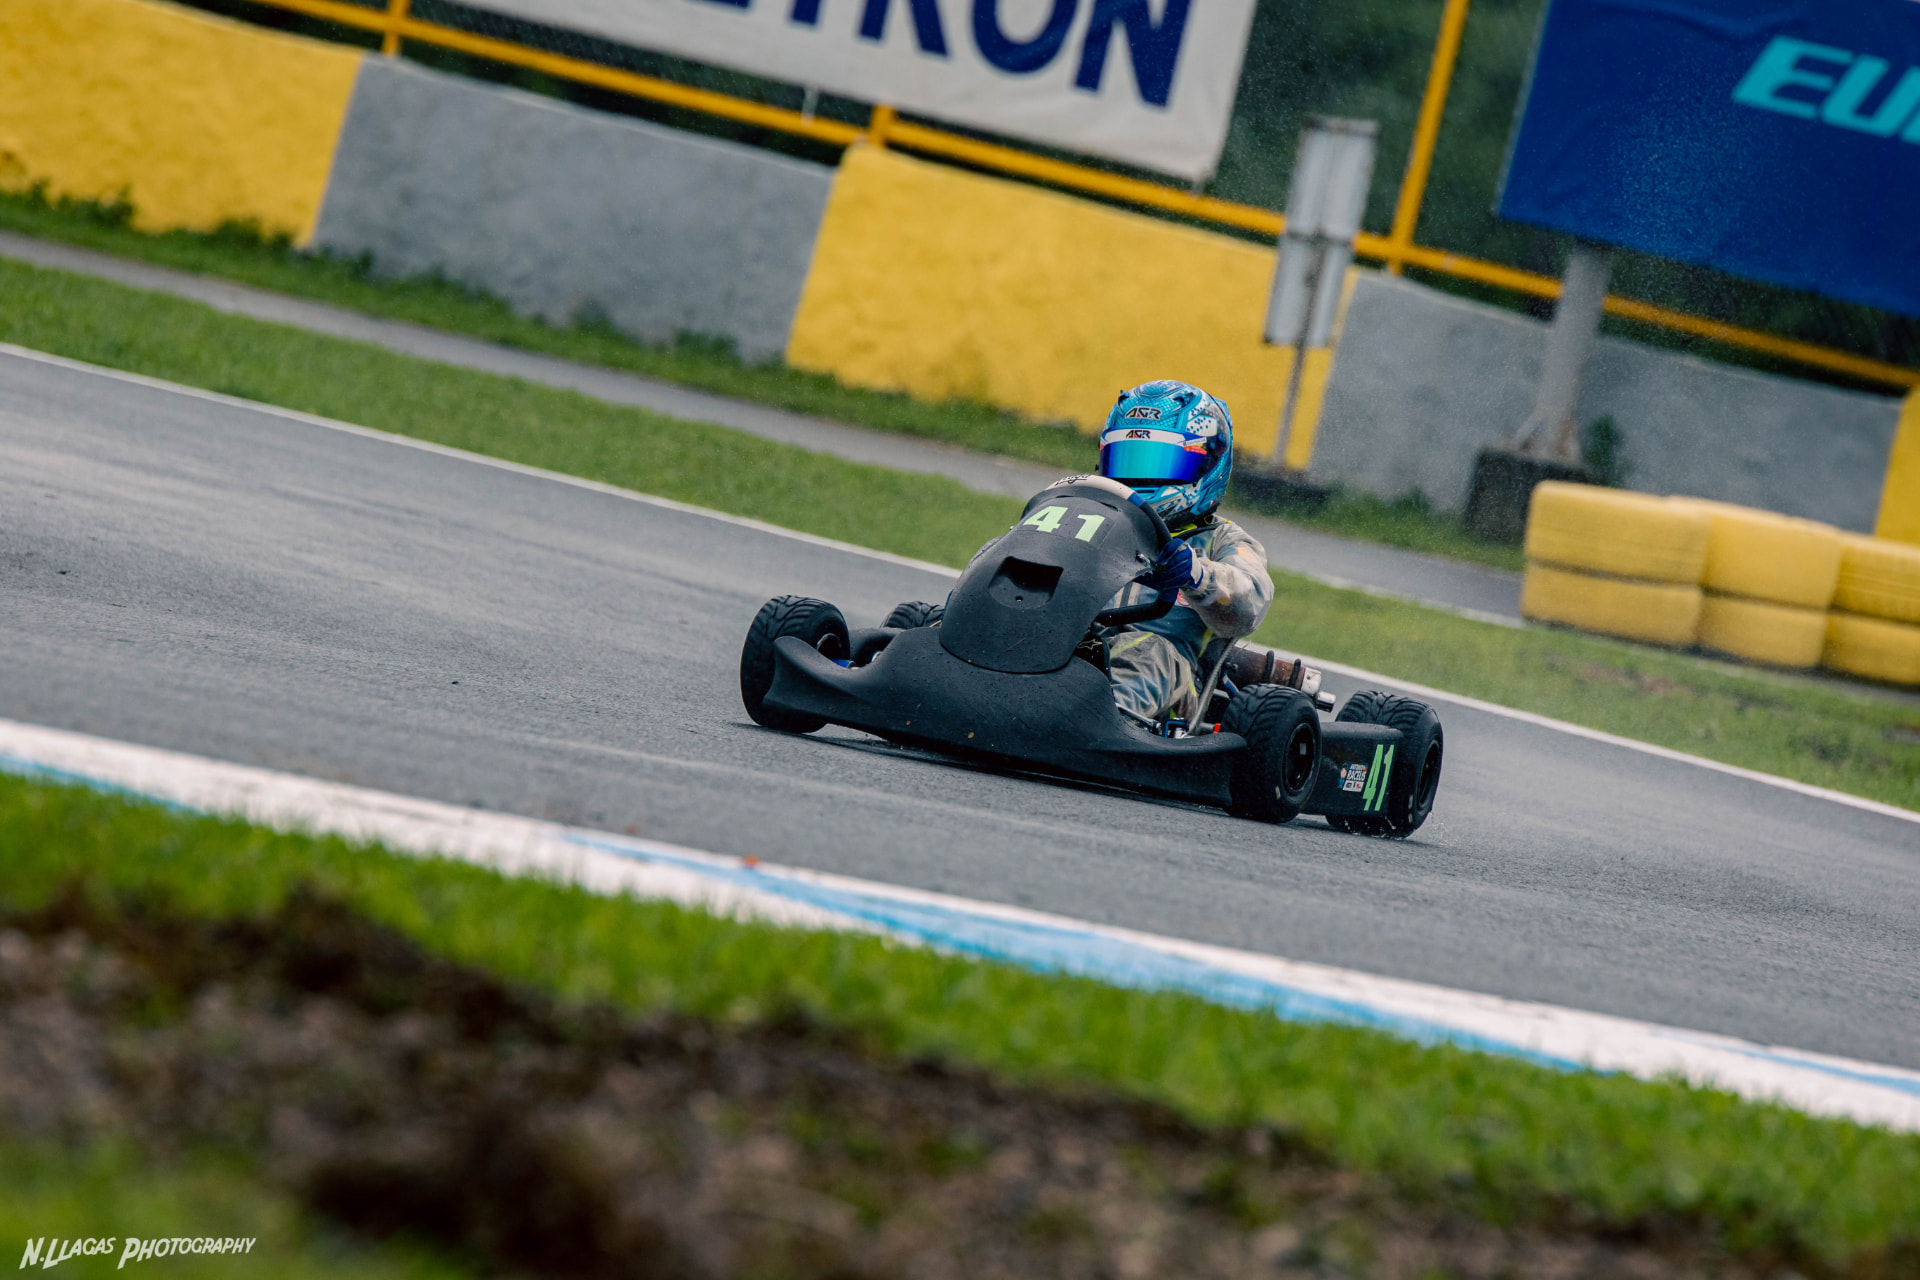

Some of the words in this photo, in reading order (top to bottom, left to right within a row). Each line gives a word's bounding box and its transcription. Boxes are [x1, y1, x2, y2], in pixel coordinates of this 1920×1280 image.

[1732, 35, 1920, 143] EU
[1023, 505, 1106, 543] 41
[1362, 743, 1395, 812] 41
